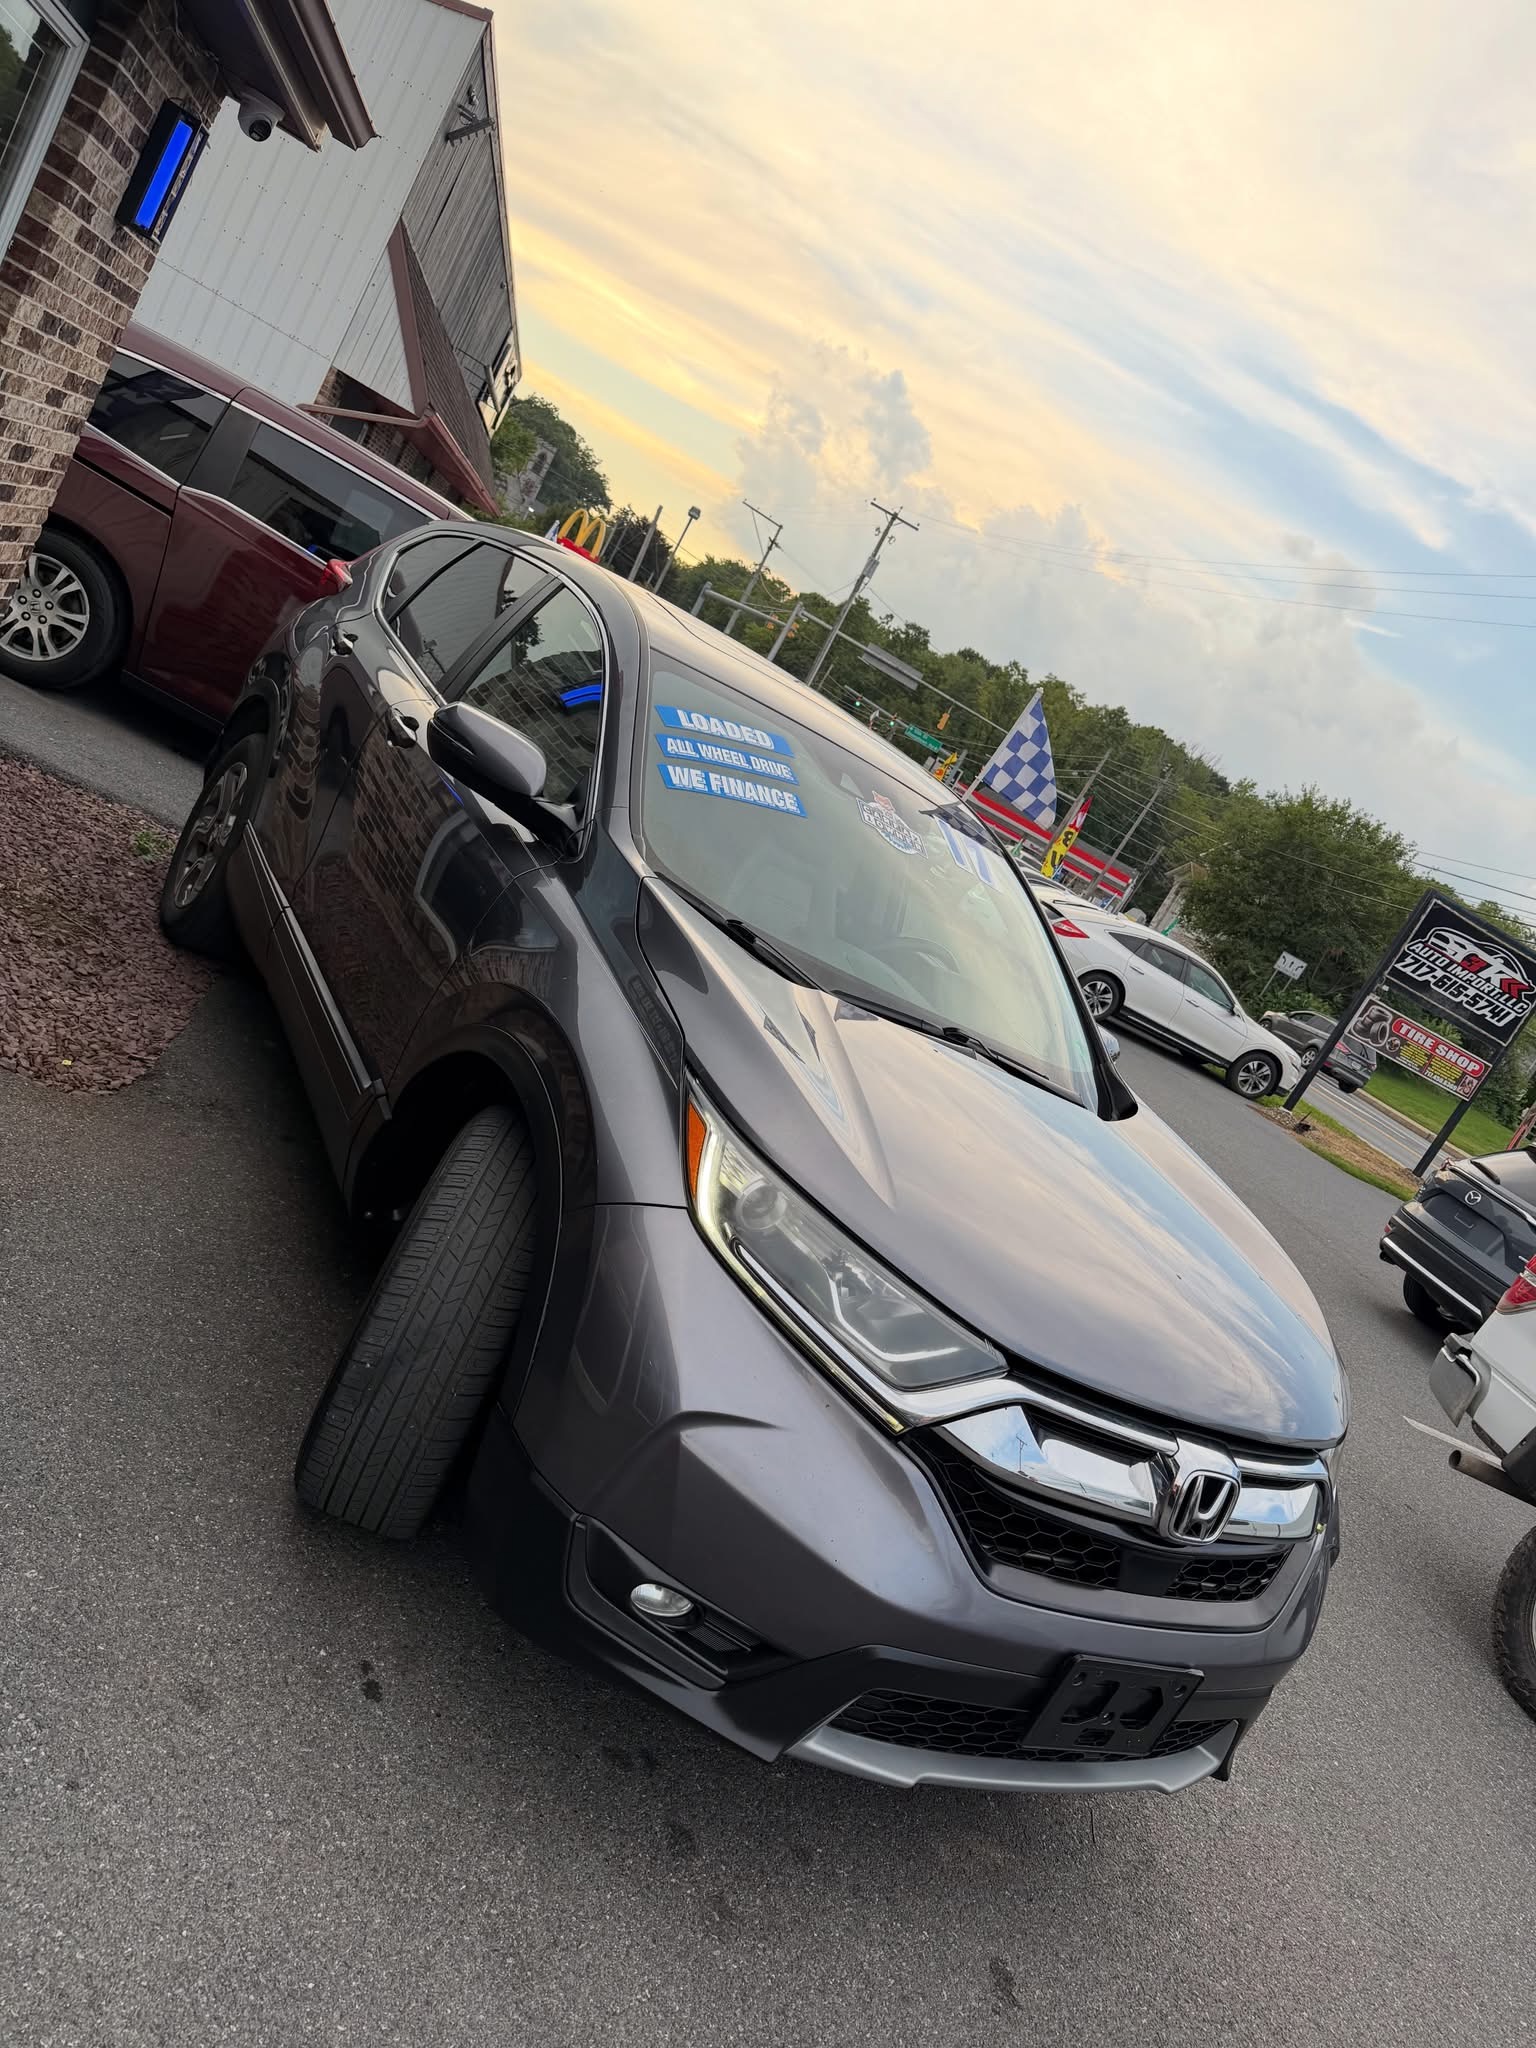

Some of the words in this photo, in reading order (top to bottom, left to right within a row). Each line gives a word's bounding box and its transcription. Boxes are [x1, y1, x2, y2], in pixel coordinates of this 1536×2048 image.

[677, 709, 775, 750] LOADED
[667, 738, 699, 758] ALL
[697, 743, 752, 769] WHEEL
[750, 756, 794, 781] DRIVE
[667, 765, 708, 791] WE
[708, 772, 800, 814] FINANCE
[1399, 954, 1512, 1026] 717-615-5741
[1410, 943, 1450, 967] AUTO
[1446, 966, 1502, 1001] IMPORT
[1499, 994, 1530, 1013] LLC
[1399, 1022, 1435, 1049] TIRE
[1435, 1044, 1480, 1072] SHOP
